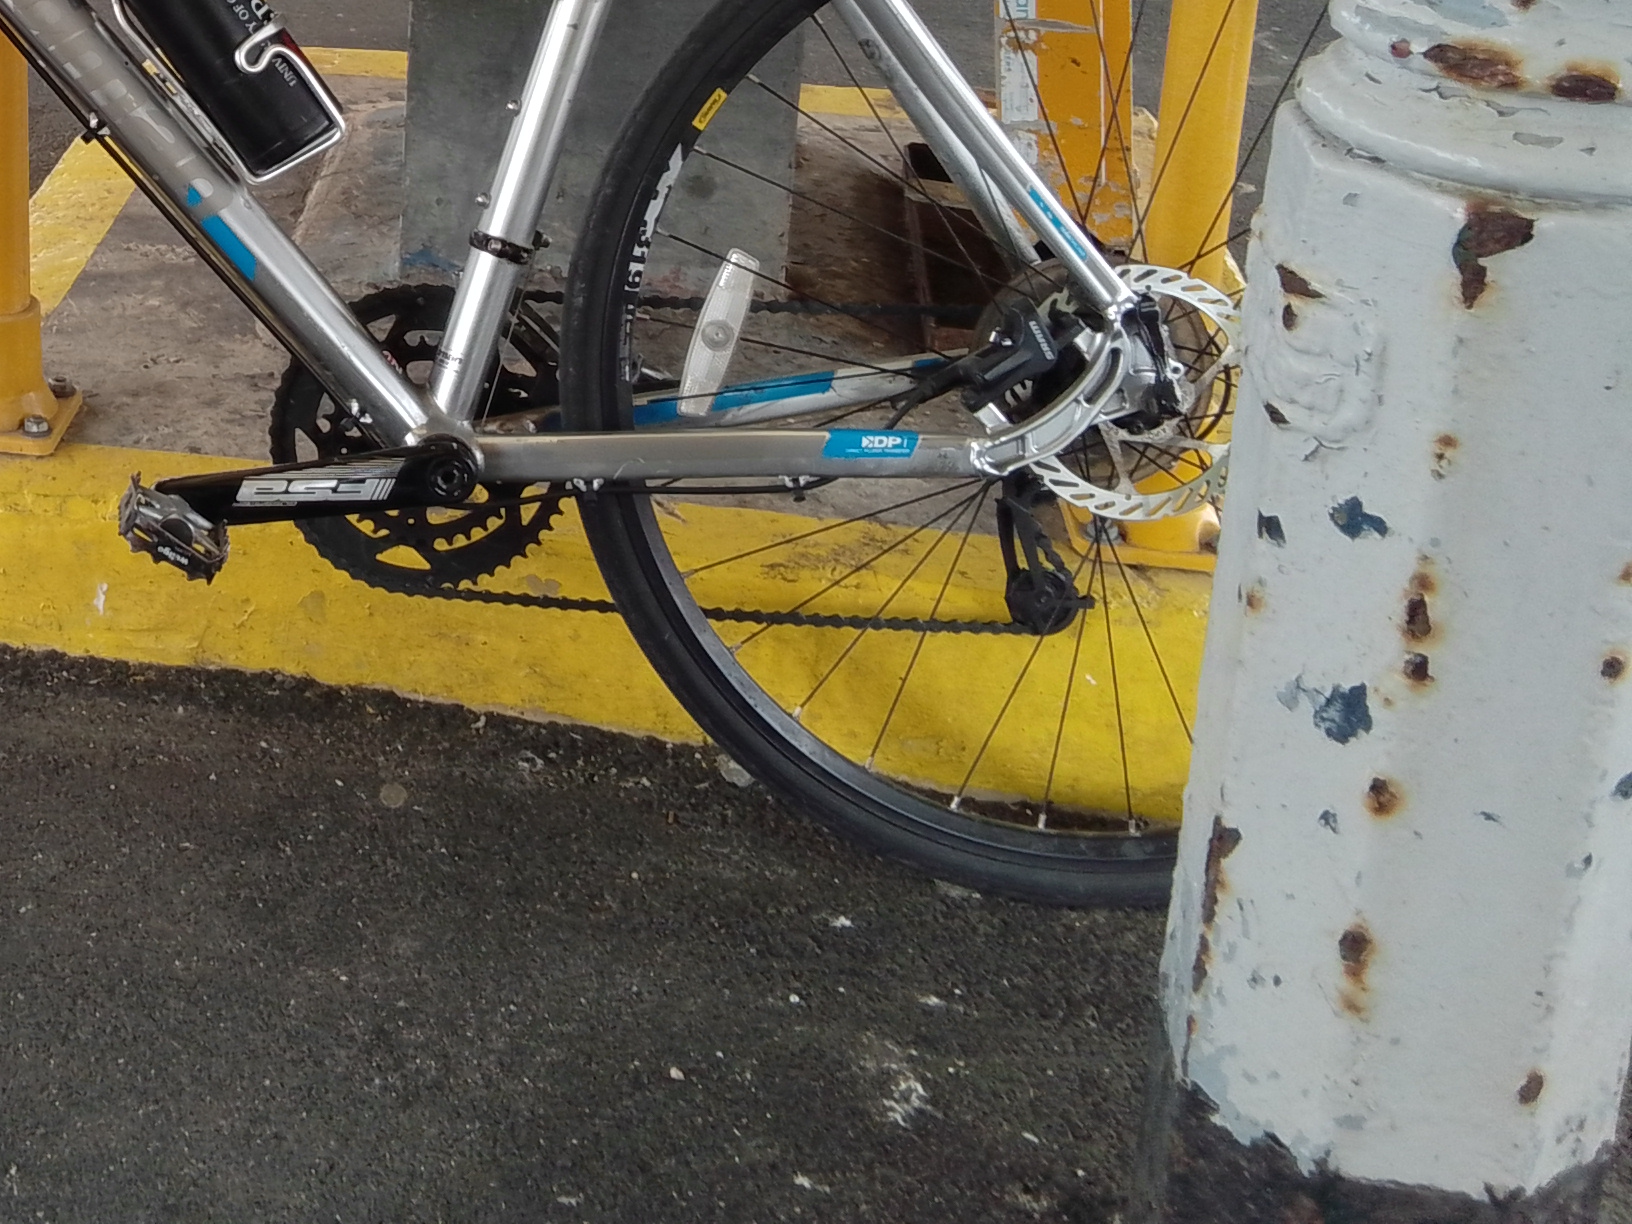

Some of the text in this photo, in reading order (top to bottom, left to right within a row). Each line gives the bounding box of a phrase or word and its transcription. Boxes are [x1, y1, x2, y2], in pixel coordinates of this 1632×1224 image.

[232, 3, 249, 21] OF
[1028, 320, 1054, 361] SRAM
[156, 544, 190, 566] wellgo
